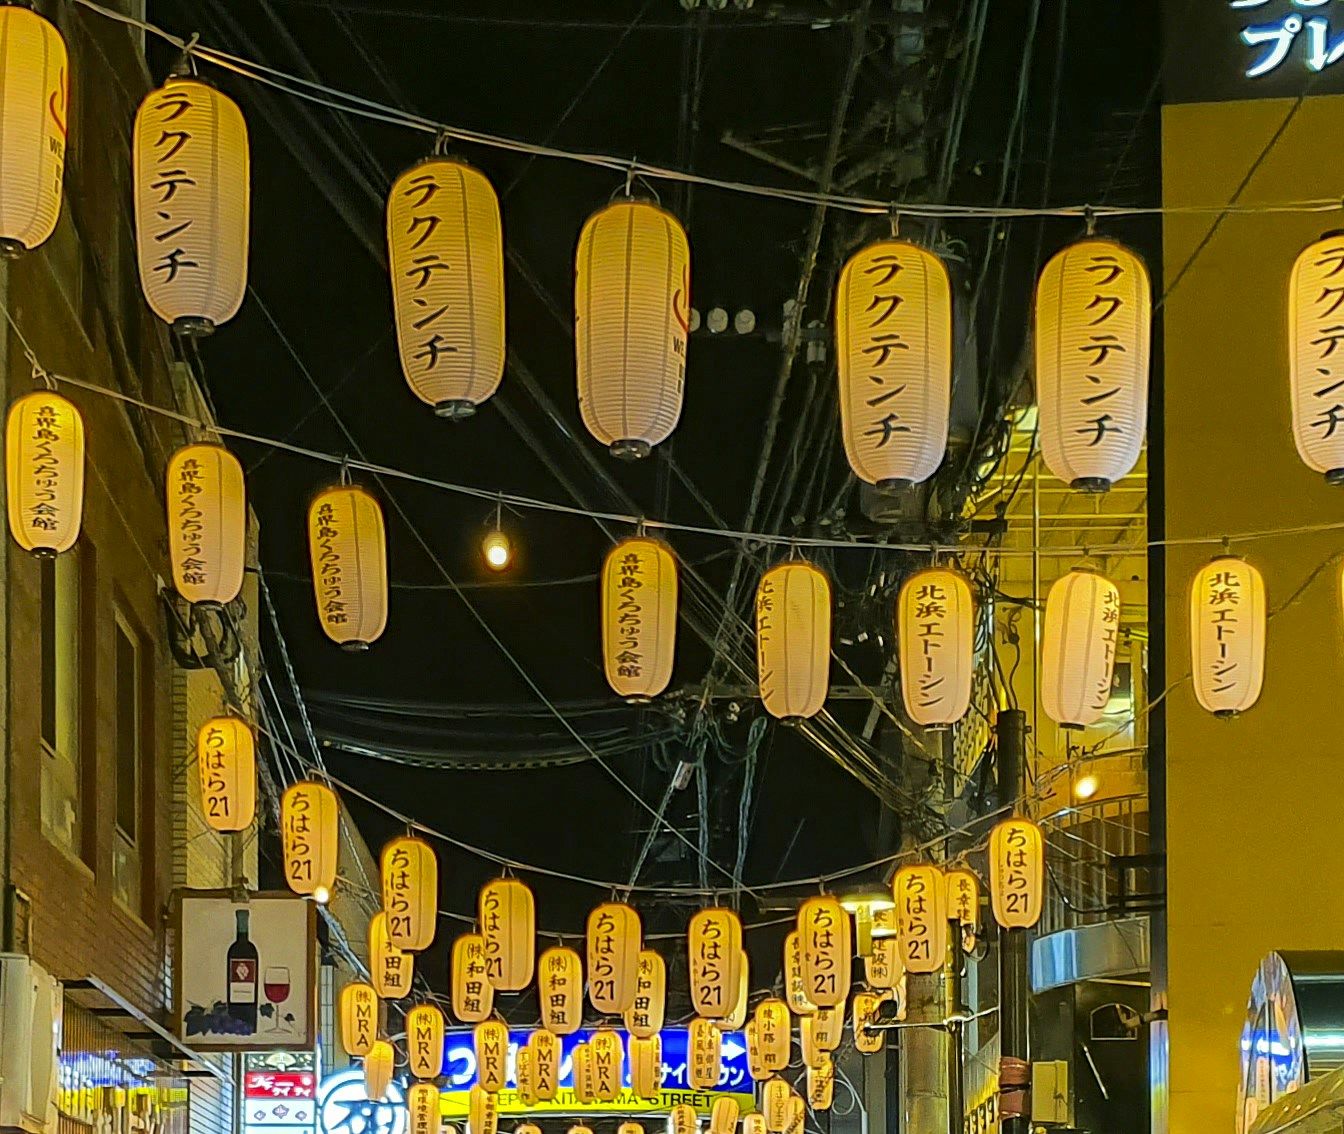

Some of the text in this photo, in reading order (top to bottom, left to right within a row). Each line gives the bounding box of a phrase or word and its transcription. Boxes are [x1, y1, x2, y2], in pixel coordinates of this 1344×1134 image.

[151, 93, 198, 283] ラクテンチ
[404, 174, 456, 372] ラクテンチ
[862, 254, 909, 449] ラクテンチ
[1077, 256, 1126, 447] ラクテンチ
[916, 585, 947, 707] 北浜エトーシン
[1209, 572, 1241, 693] 北浜エトーシン
[205, 728, 230, 818] ちはら21
[290, 792, 312, 880] ちはら21
[1006, 828, 1029, 913] ちはら21
[390, 849, 411, 938] ちはら21
[485, 891, 503, 979] ちはら21
[906, 874, 930, 960] ちはら21
[595, 914, 615, 1001] ちはら21
[700, 920, 721, 1005] ちはら21
[813, 908, 835, 994] ちはら21
